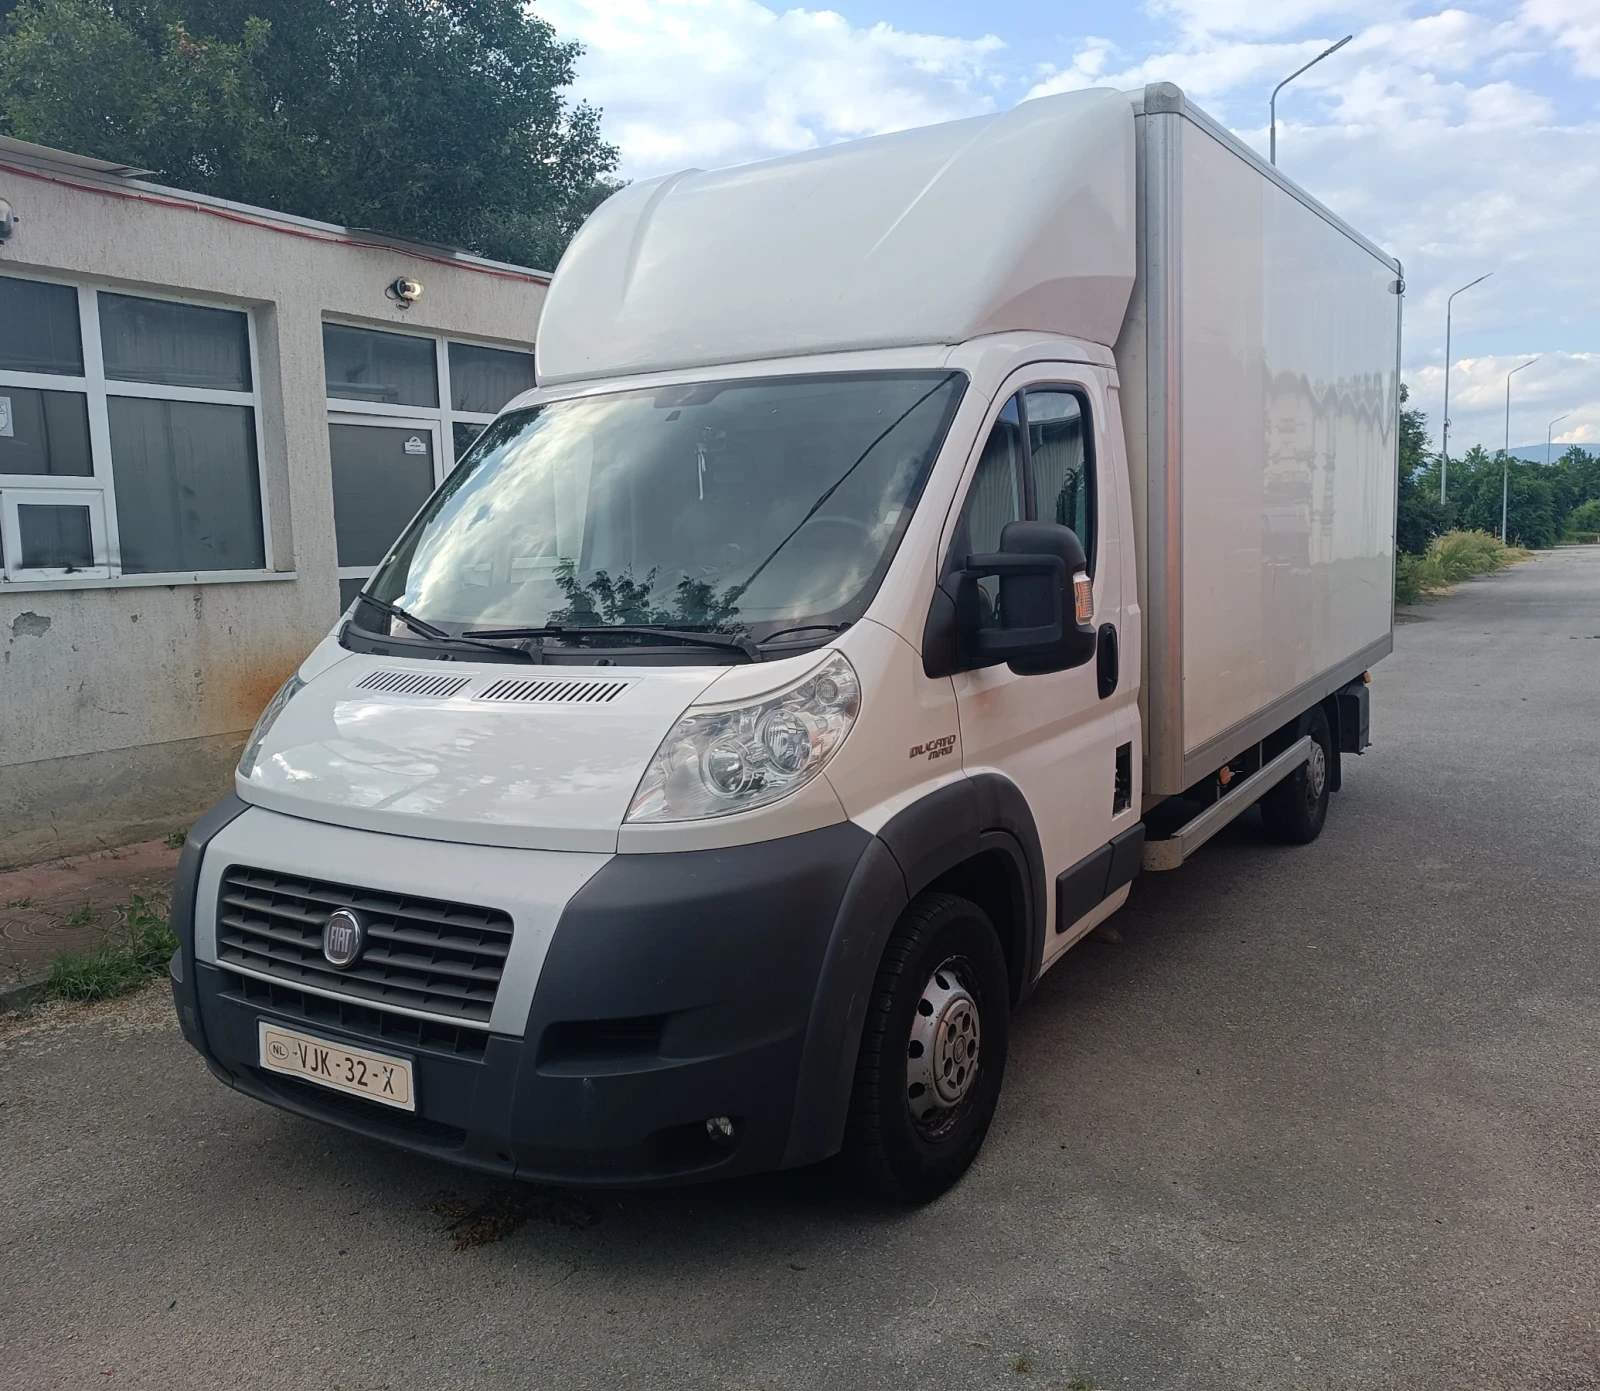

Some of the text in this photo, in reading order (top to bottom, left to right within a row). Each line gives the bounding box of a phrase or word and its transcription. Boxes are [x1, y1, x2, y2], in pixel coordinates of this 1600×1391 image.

[909, 734, 956, 759] DUCATO
[928, 744, 953, 761] MAXI
[330, 926, 352, 953] FIAT
[272, 1042, 394, 1095] NL VJK-32-X
